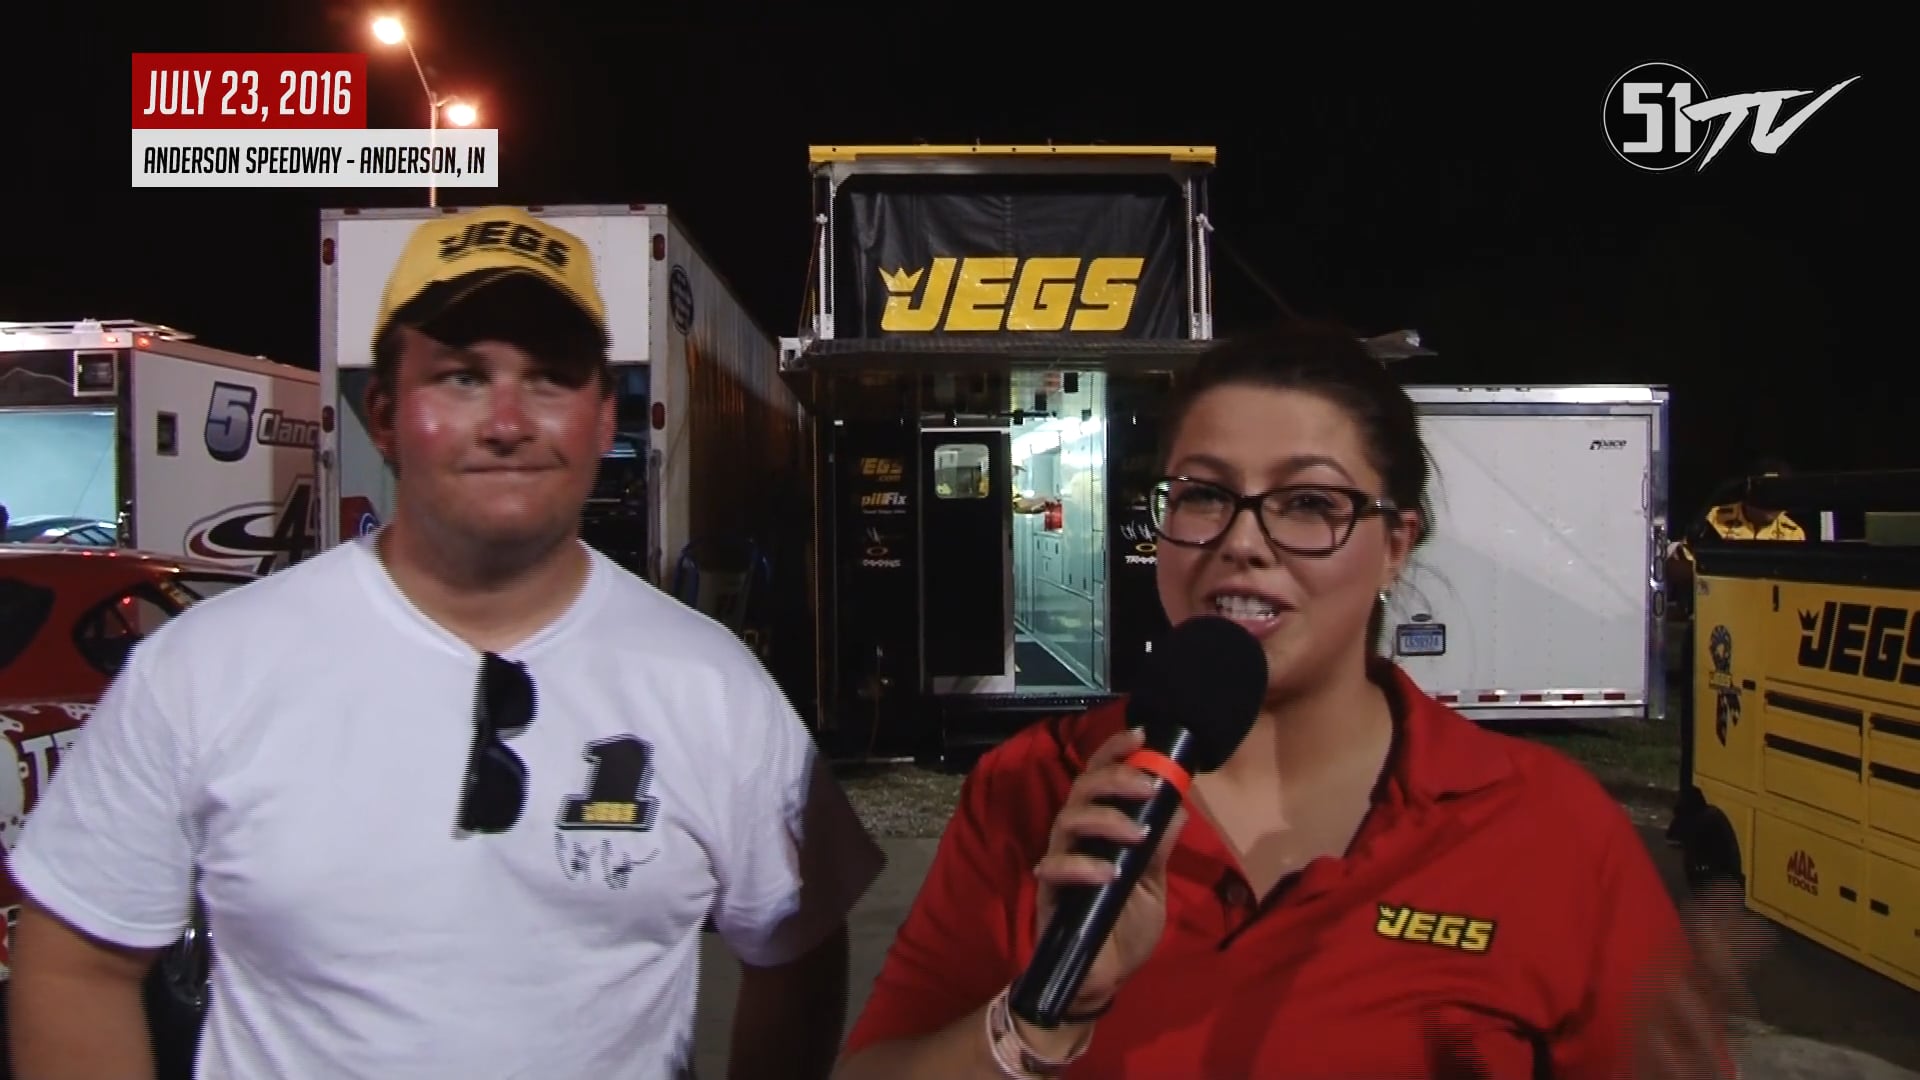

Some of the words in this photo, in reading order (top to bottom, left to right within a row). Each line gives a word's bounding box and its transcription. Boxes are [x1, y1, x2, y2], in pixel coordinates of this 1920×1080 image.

[439, 221, 571, 266] JEGS
[880, 257, 1145, 332] JEGS
[204, 381, 258, 462] 5
[258, 409, 320, 447] Clanc
[860, 457, 904, 475] EGS
[1787, 849, 1819, 885] MAC
[1377, 905, 1494, 951] JEGS
